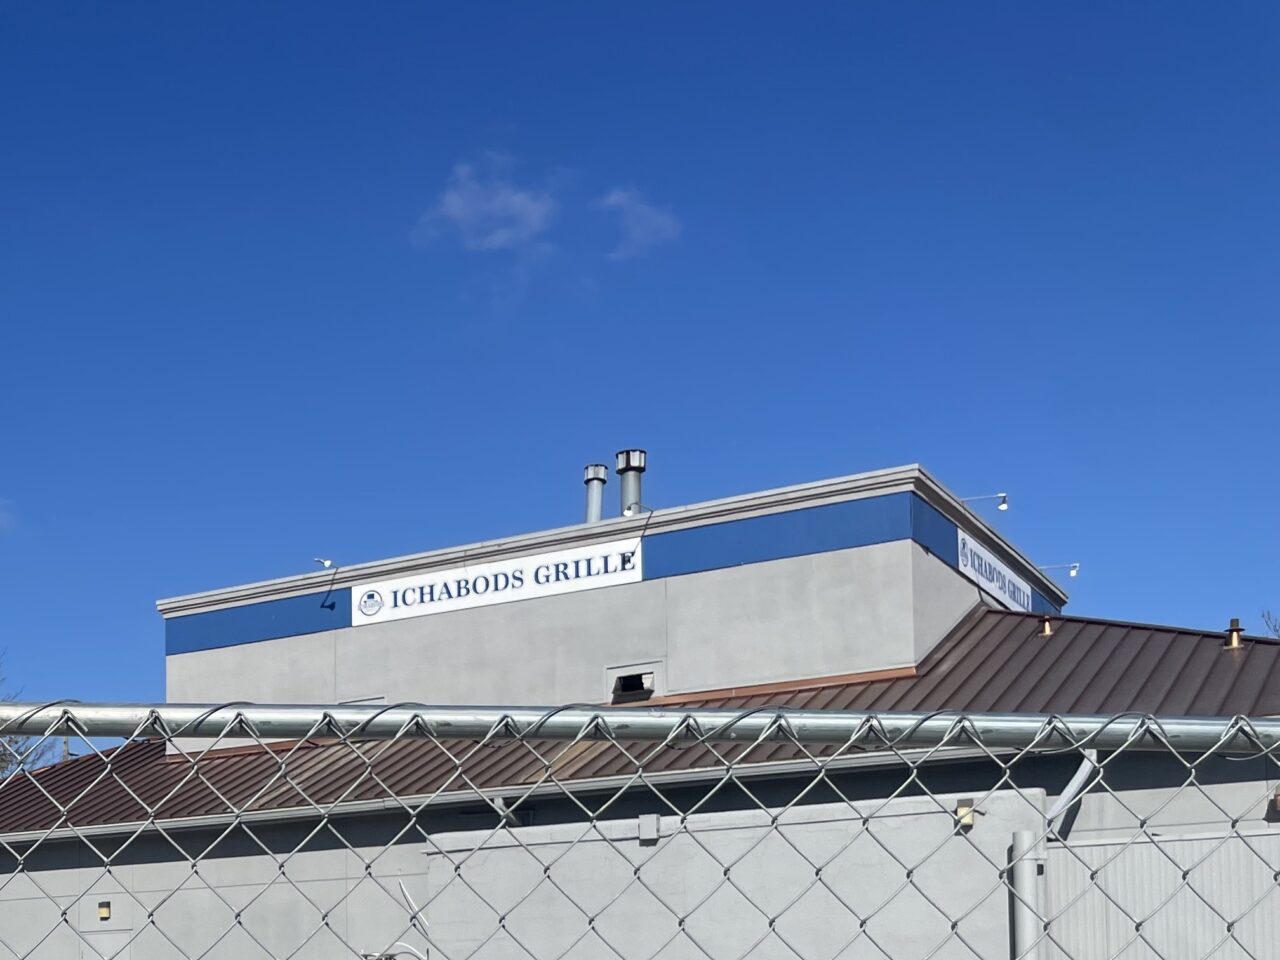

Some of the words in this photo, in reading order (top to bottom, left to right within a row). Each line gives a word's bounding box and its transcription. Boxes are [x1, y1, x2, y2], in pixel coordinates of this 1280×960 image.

[391, 570, 524, 609] ICHABODS
[533, 551, 636, 585] GRILLE
[969, 548, 1006, 595] ICHABODS
[1007, 578, 1030, 611] GRILLE
